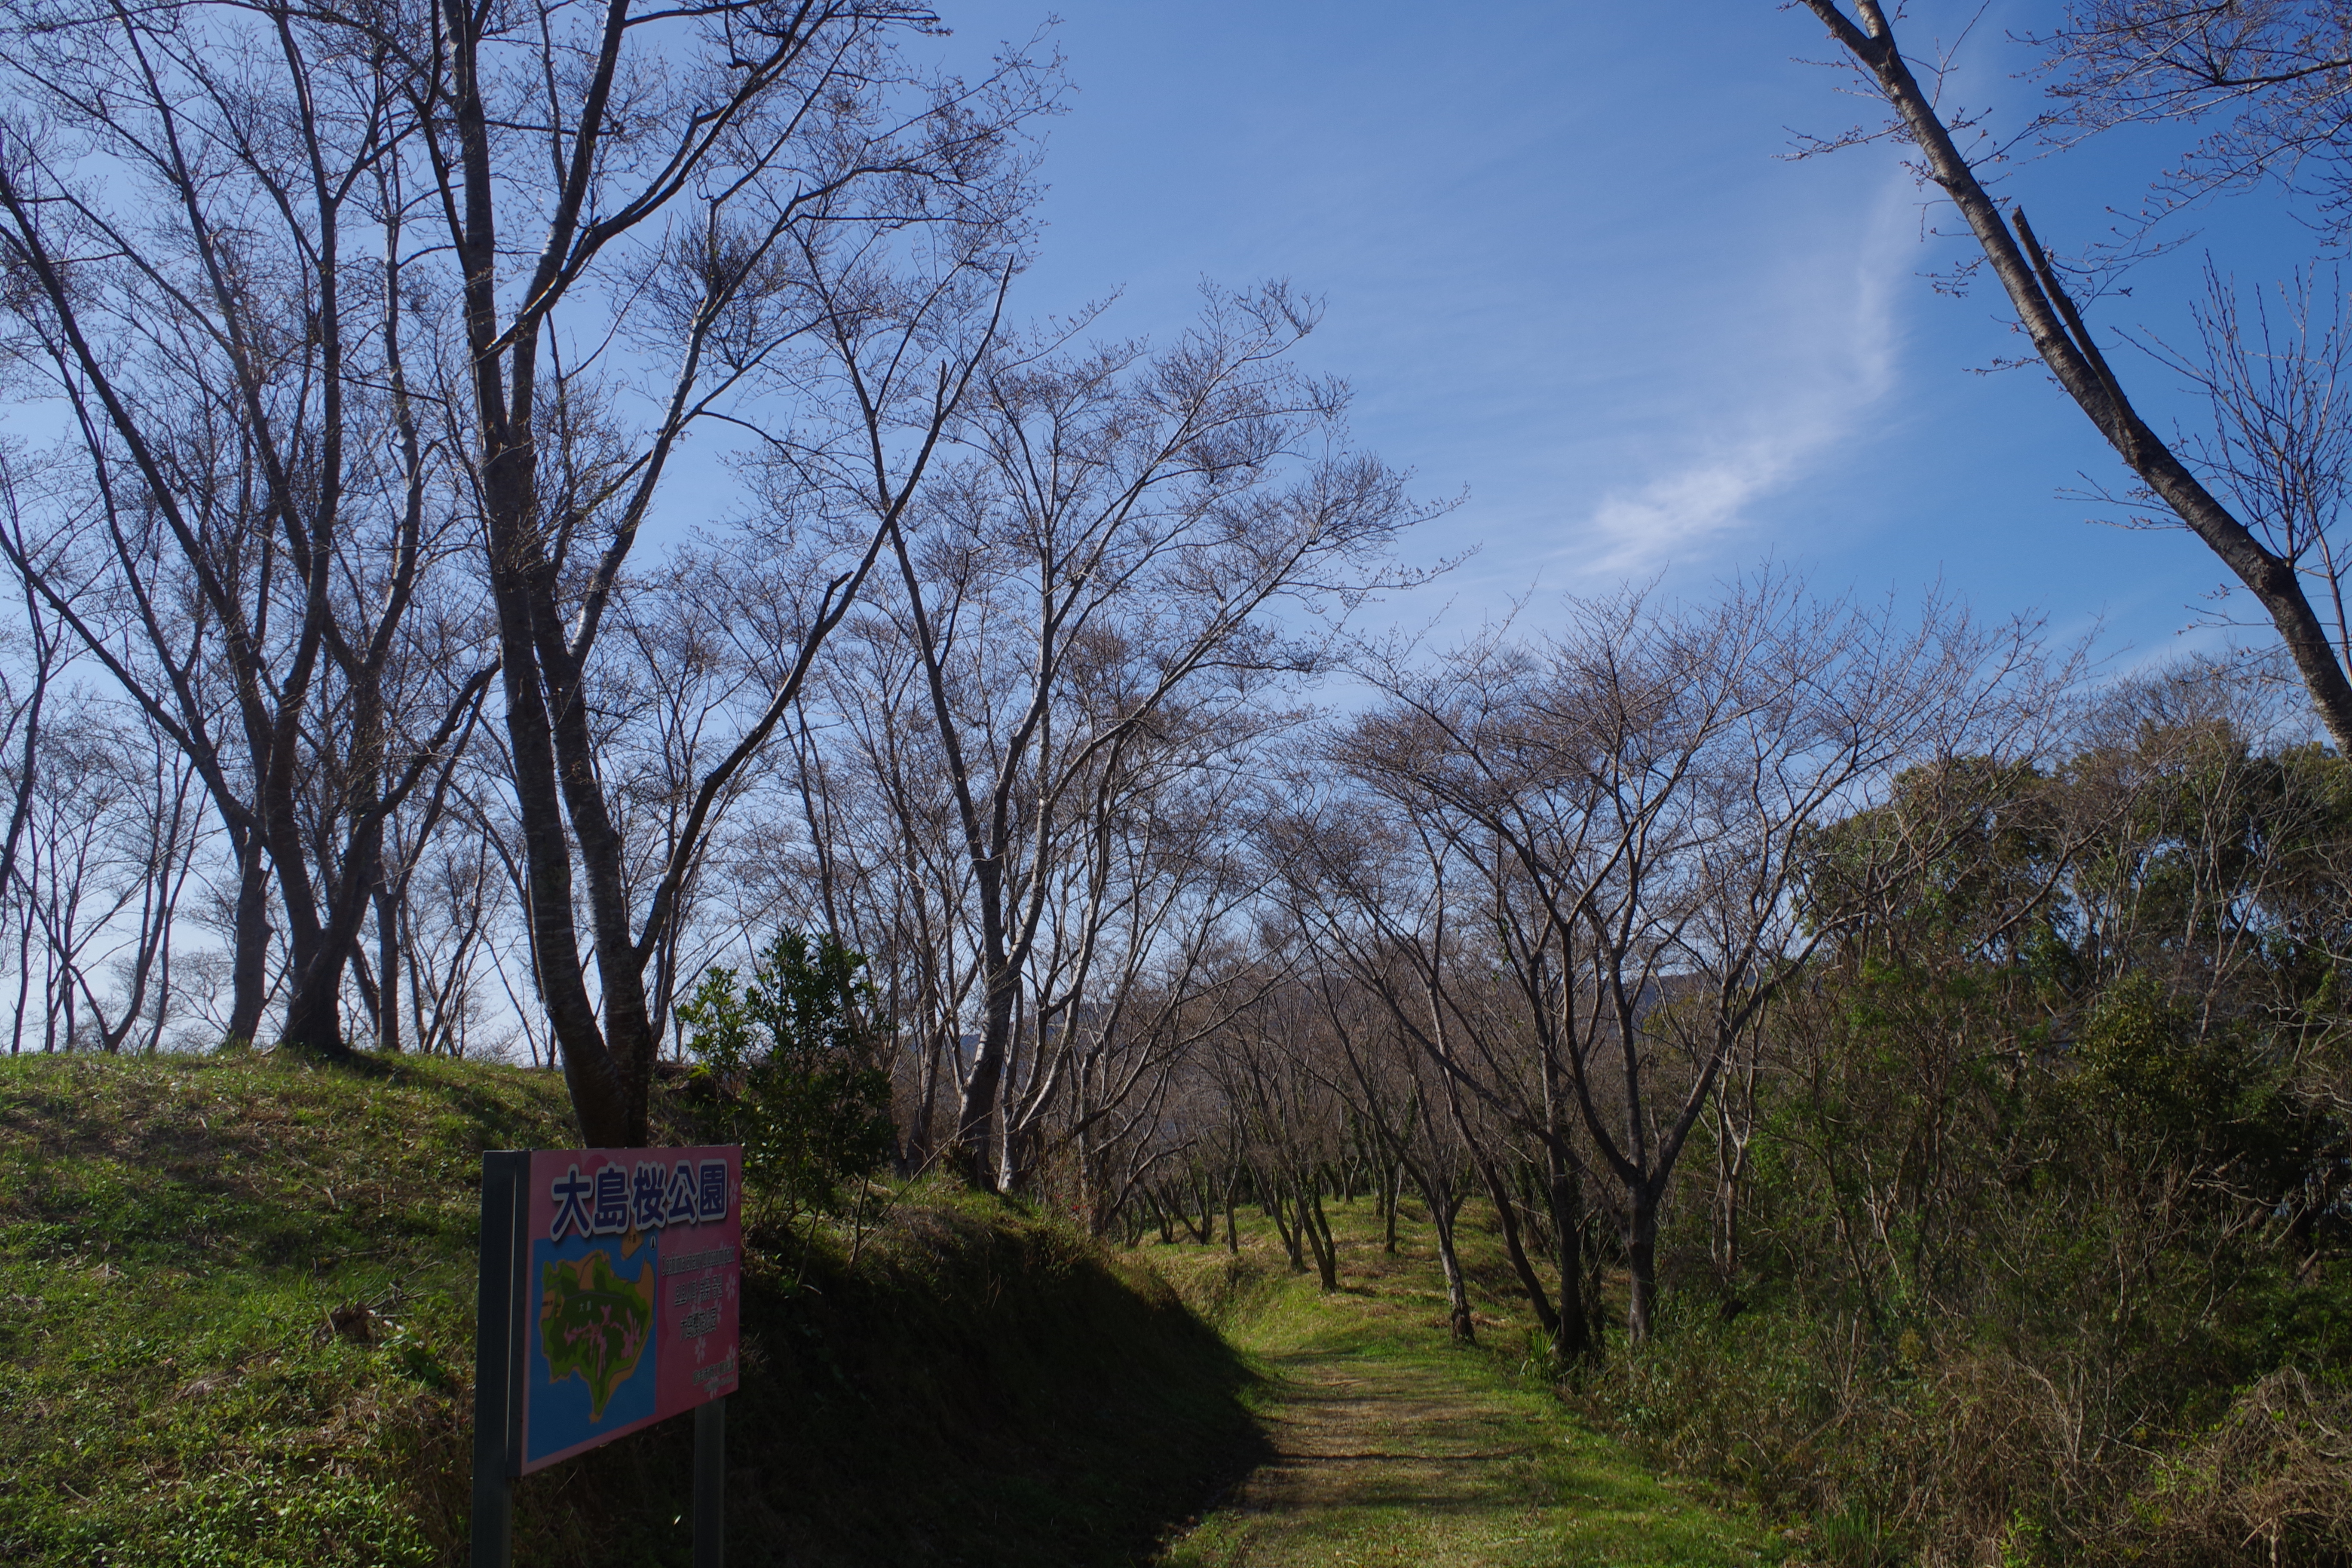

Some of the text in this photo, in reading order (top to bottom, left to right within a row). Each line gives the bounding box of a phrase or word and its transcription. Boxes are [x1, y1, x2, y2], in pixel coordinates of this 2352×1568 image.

[551, 1159, 727, 1240] 大島桜公園
[662, 1240, 735, 1276] Ooshima cherry blossom park
[675, 1278, 698, 1306] 오오시마
[712, 1273, 723, 1299] 공원
